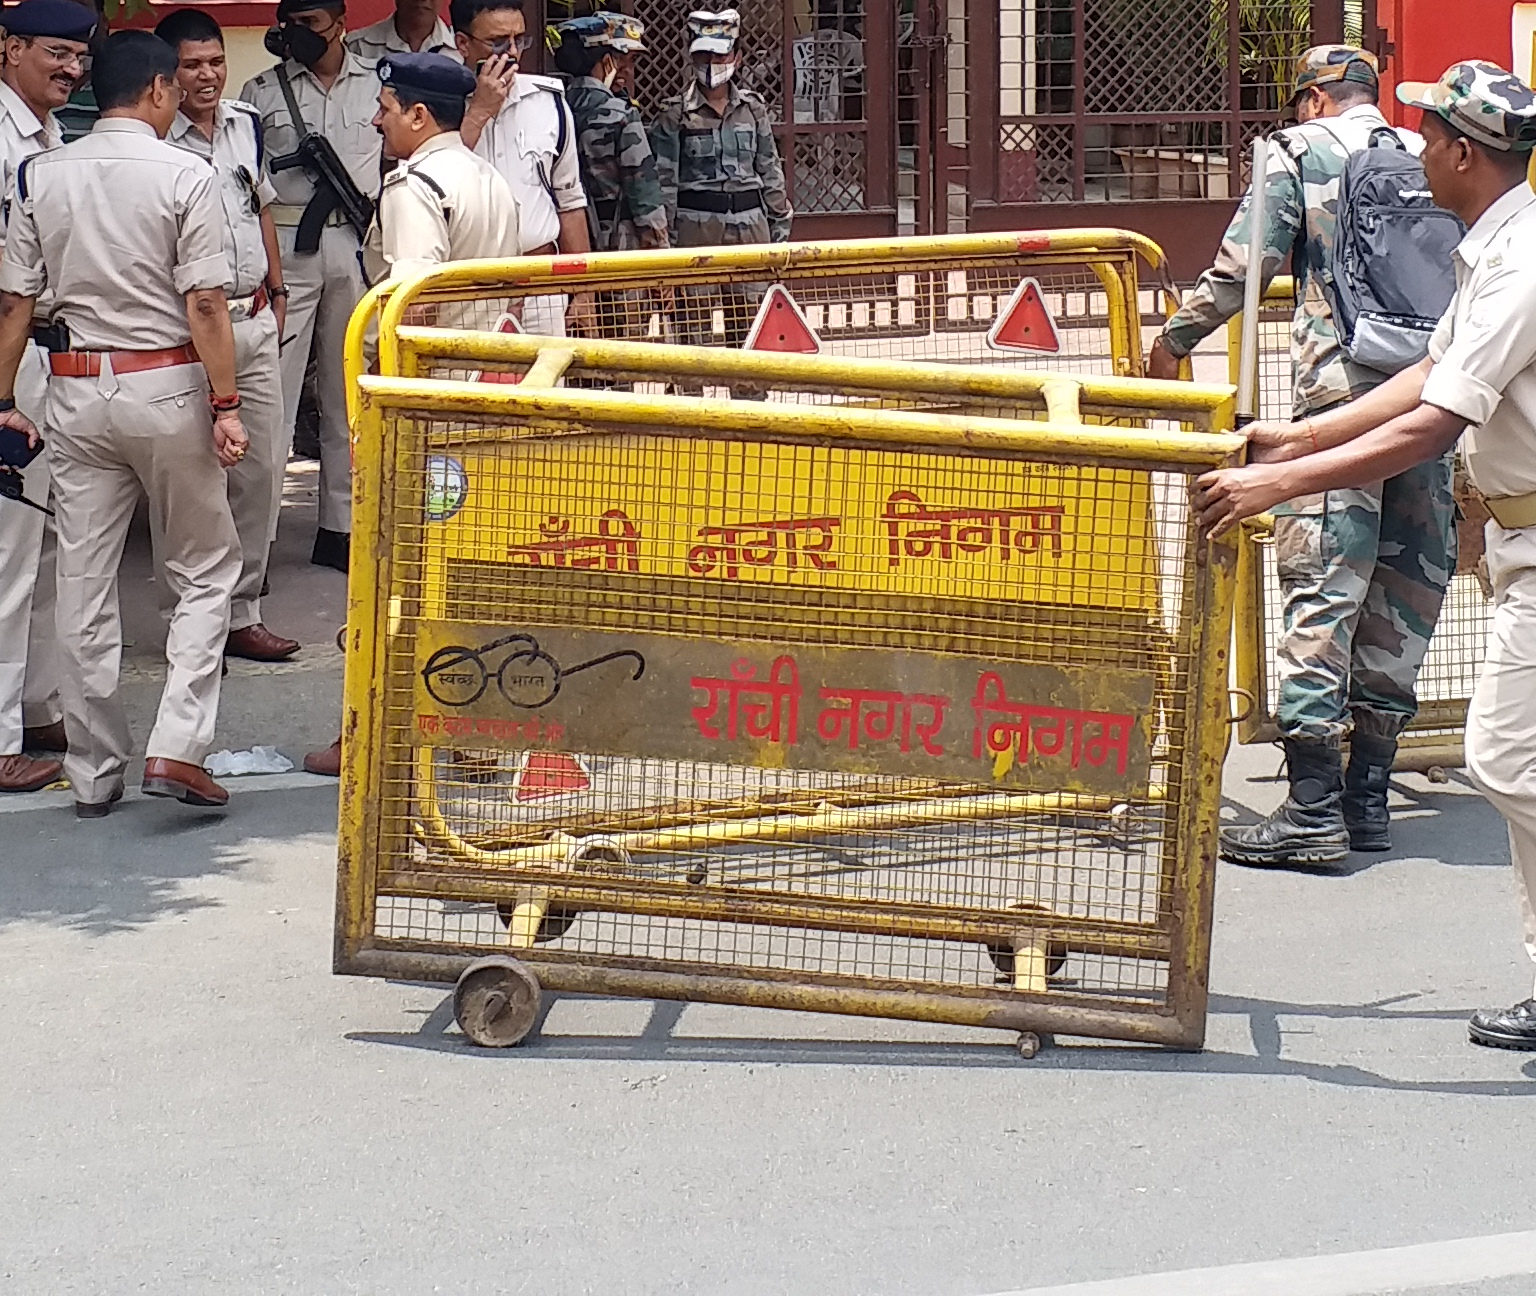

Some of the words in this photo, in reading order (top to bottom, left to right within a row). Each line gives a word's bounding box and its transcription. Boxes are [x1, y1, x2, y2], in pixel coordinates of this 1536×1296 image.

[688, 517, 842, 578] नगर
[881, 489, 1065, 567] निगम
[689, 654, 803, 745] राँची
[817, 687, 951, 757] नगर
[971, 670, 1136, 775] निगम
